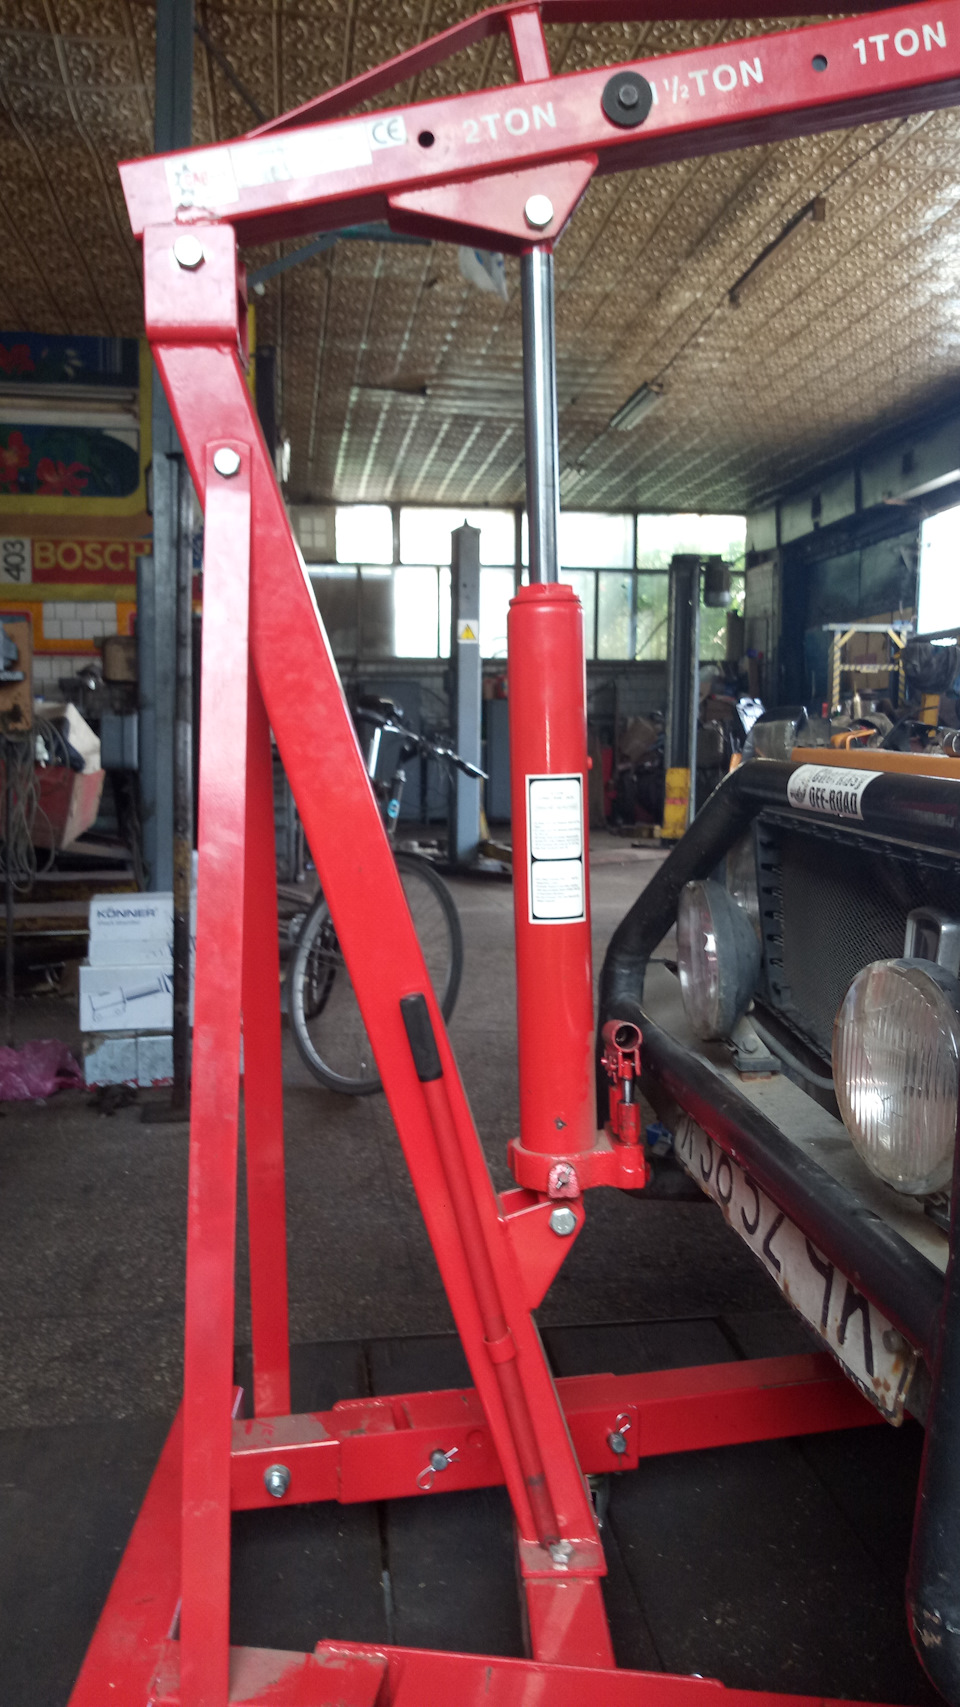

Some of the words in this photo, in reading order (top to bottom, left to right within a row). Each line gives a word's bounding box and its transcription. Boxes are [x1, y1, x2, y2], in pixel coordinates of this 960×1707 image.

[853, 21, 947, 64] 1TON
[371, 117, 403, 145] CE
[463, 103, 557, 144] 2TON
[3, 540, 26, 581] 403
[33, 541, 152, 571] BOSCH
[809, 786, 858, 815] OFF-ROAD
[97, 907, 156, 918] KÖNNER
